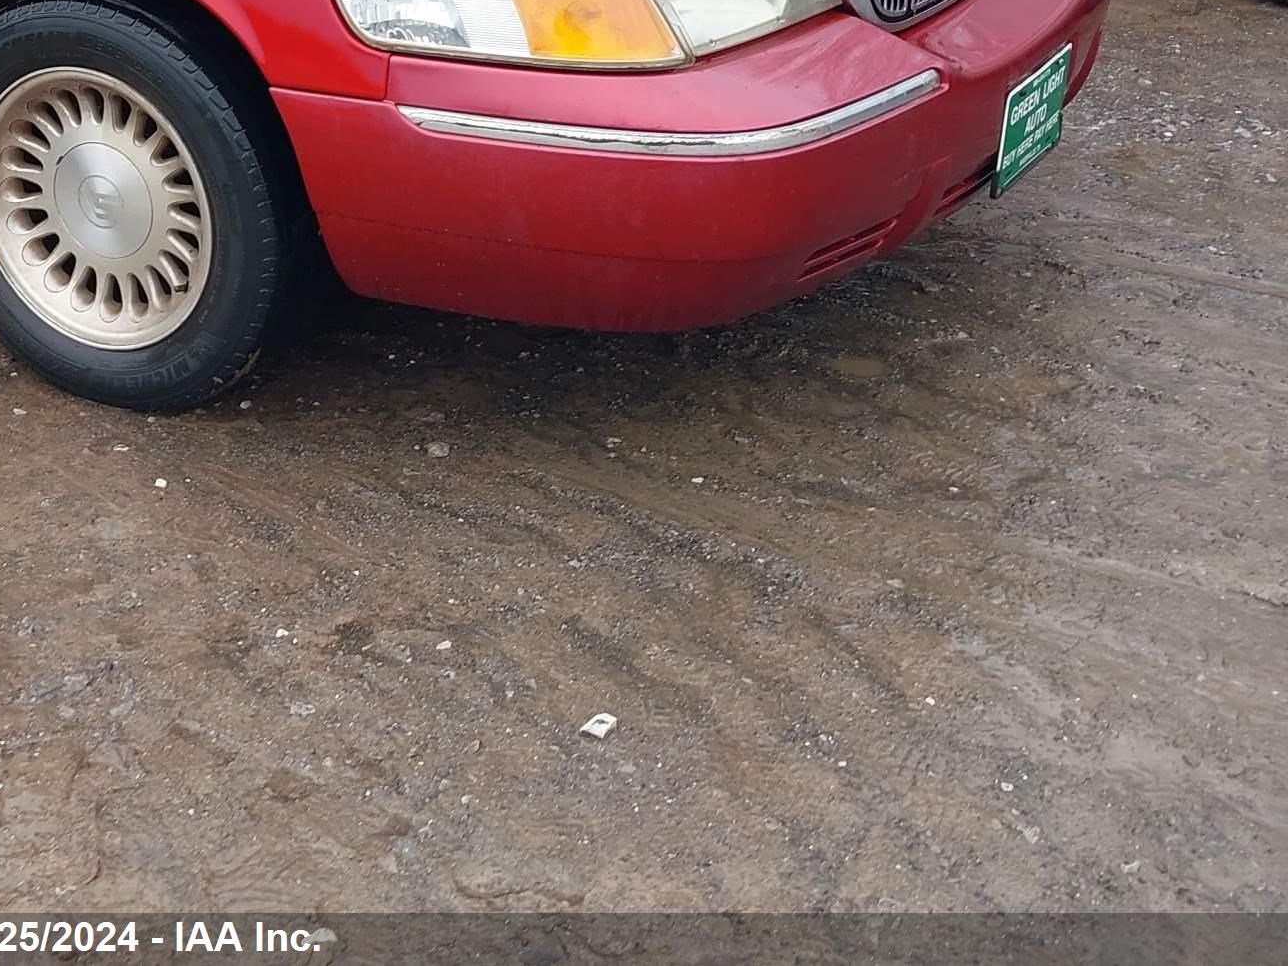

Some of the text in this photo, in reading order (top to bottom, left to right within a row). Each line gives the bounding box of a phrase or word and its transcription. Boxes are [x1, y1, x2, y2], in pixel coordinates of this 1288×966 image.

[1010, 87, 1041, 126] GREEN
[1042, 65, 1066, 100] LIGHT
[1023, 103, 1048, 136] AUTO
